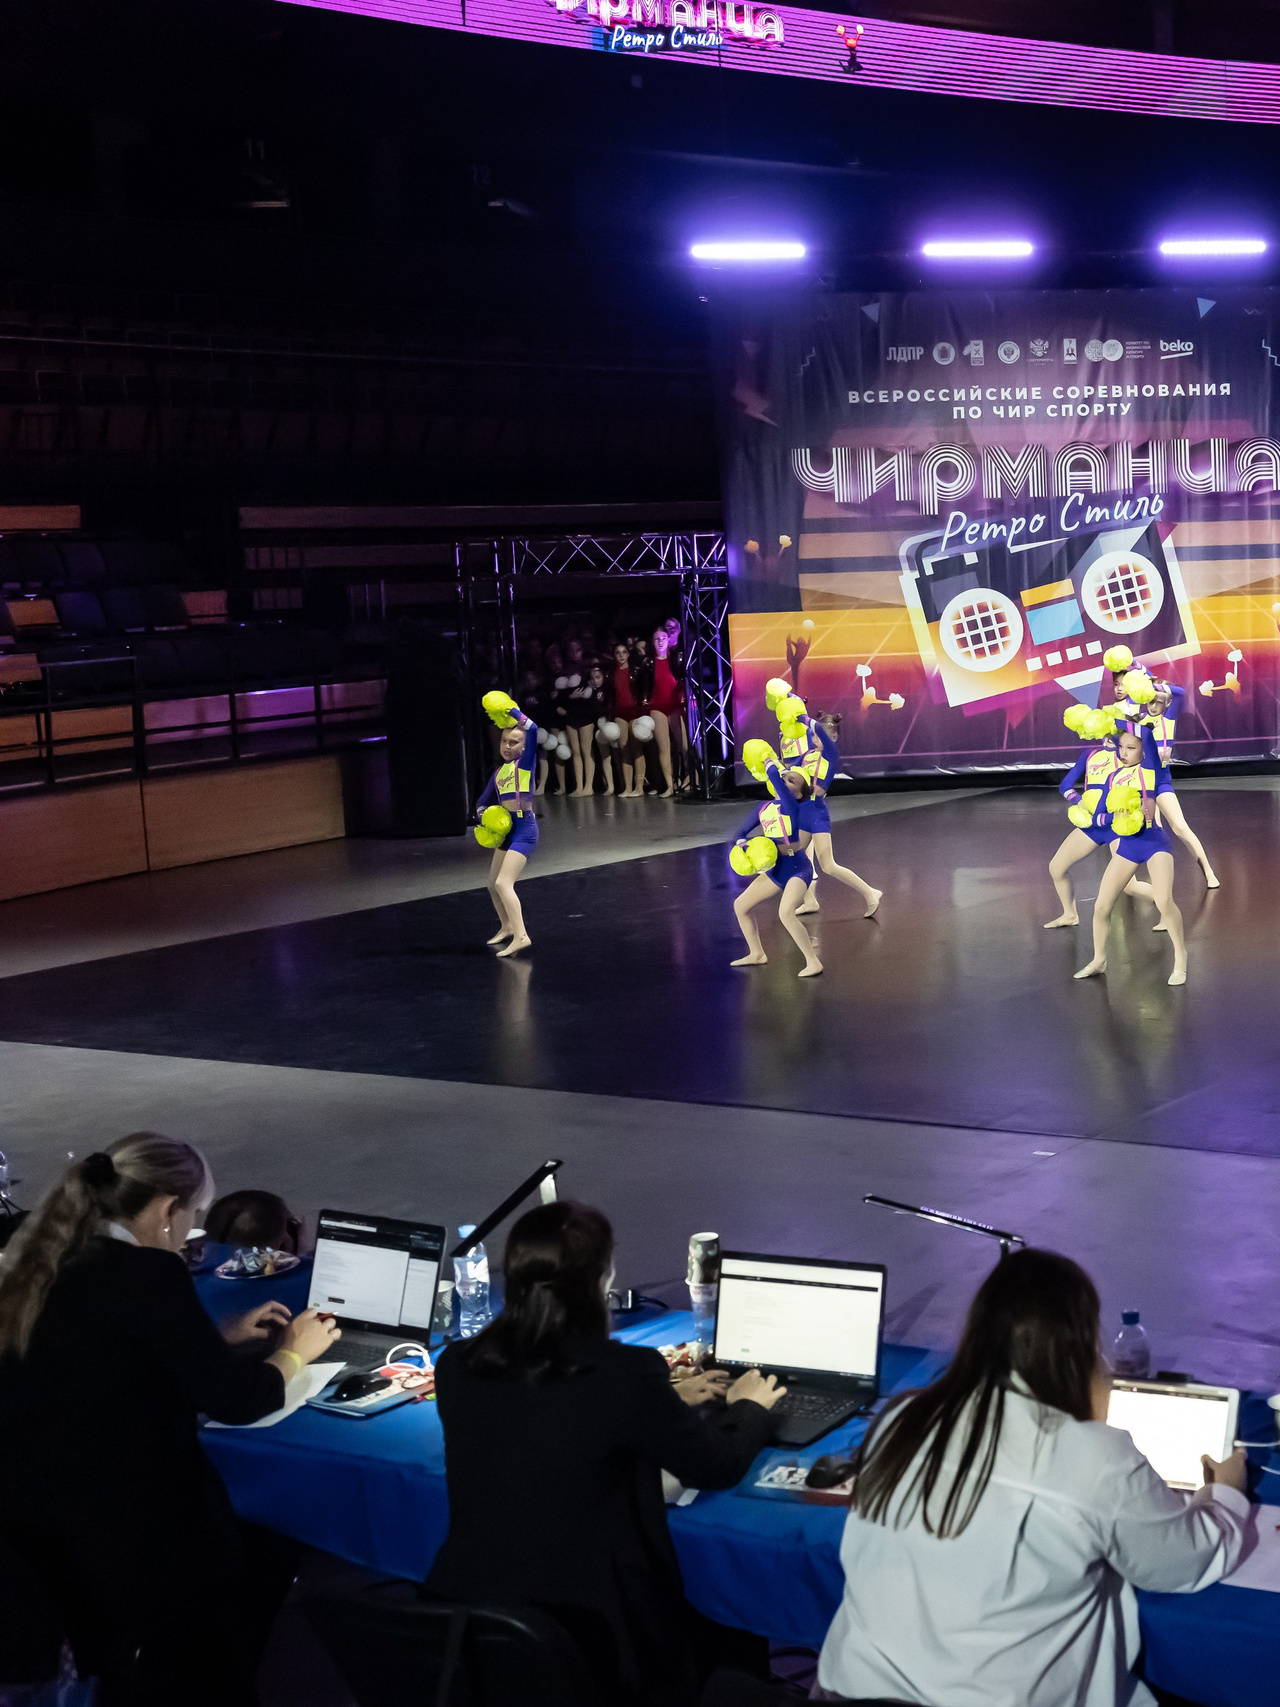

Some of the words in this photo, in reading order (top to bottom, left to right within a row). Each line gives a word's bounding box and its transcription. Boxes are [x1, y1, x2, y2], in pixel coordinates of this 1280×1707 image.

[612, 25, 665, 52] Ретро
[670, 24, 723, 48] Стиль
[886, 346, 924, 363] ЛДПР
[1159, 339, 1194, 352] beko
[848, 384, 1043, 404] ВСЕРОССИЙСКИЕ
[1052, 382, 1232, 400] СОРЕВНОВАНИЯ
[952, 405, 983, 420] ПО
[992, 404, 1036, 419] ЧИР
[1046, 402, 1133, 418] СПОРТУ
[941, 511, 1047, 552] Ретро
[1060, 492, 1164, 532] Стиль
